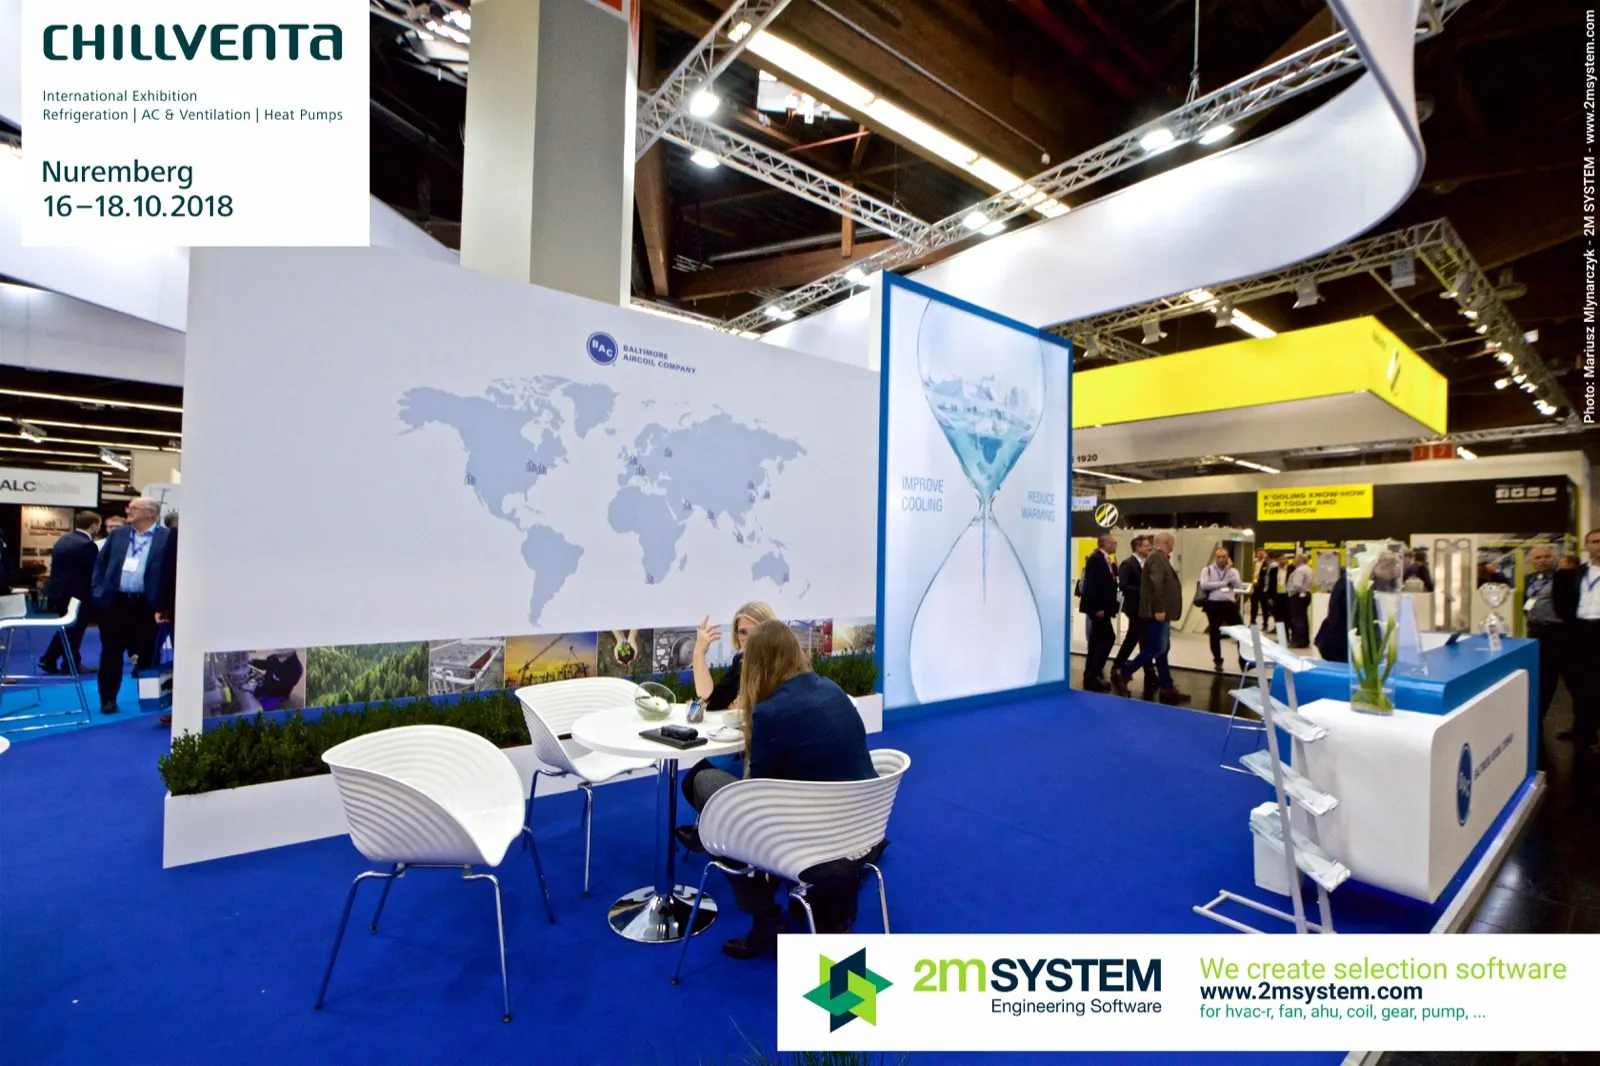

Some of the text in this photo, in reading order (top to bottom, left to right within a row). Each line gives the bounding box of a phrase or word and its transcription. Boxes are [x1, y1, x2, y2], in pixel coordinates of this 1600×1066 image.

[592, 340, 613, 357] BAC
[622, 344, 669, 360] BALTIMORE
[622, 353, 697, 375] AIRCOIL COMPANY
[1076, 453, 1099, 463] 1920
[901, 476, 945, 493] IMPROVE
[901, 496, 944, 513] COOLING
[1027, 490, 1056, 506] REDUCE
[1315, 498, 1337, 506] AND
[1021, 506, 1056, 523] WARMING
[1264, 507, 1318, 515] TOMORROW
